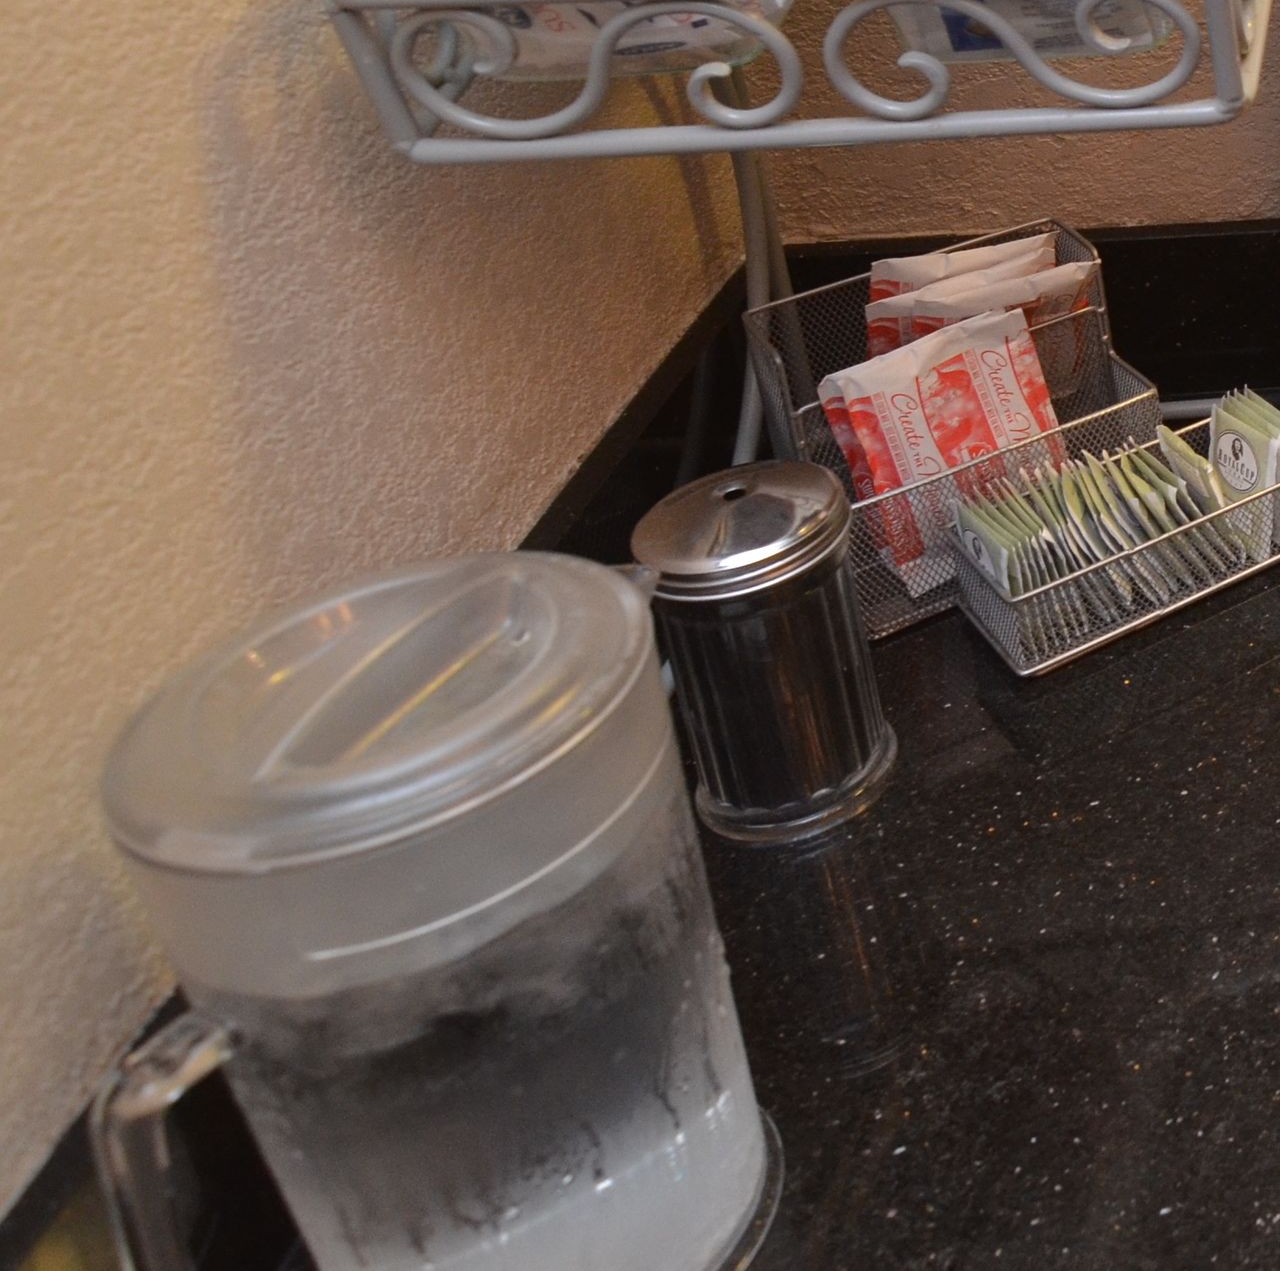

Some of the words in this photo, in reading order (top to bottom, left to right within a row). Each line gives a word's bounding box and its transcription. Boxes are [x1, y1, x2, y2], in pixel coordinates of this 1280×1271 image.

[980, 349, 1012, 407] Create
[1003, 407, 1014, 424] THE
[891, 392, 928, 453] Create
[910, 451, 924, 469] THE
